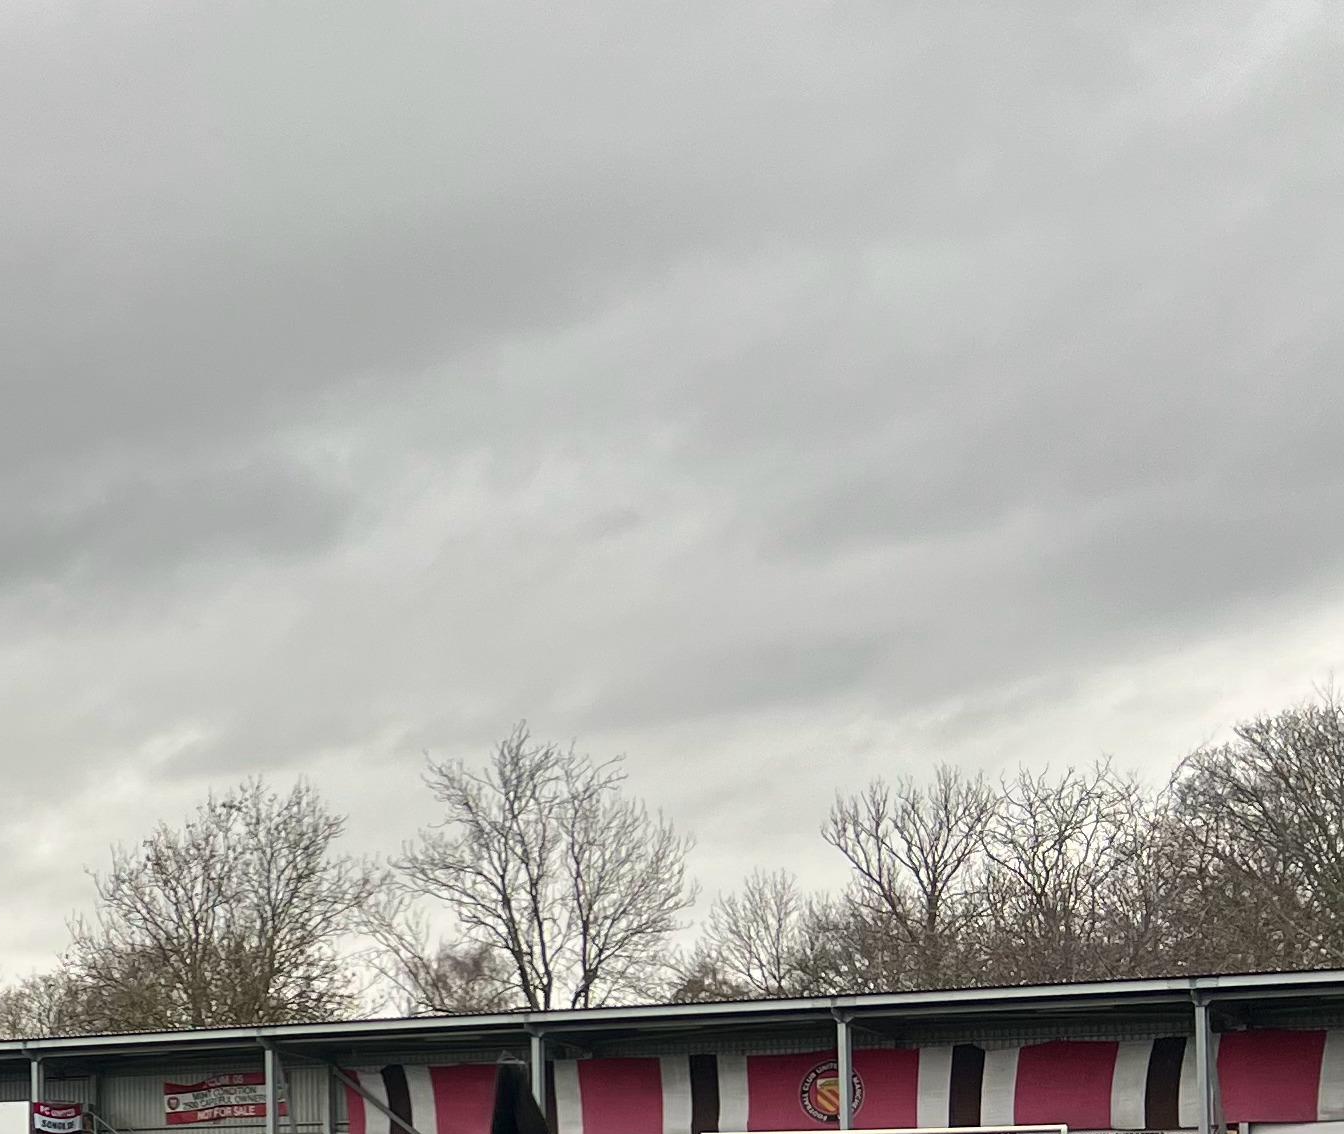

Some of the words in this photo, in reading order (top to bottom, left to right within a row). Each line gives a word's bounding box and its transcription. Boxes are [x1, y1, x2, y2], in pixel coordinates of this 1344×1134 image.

[803, 1073, 817, 1092] CLUB
[213, 1086, 257, 1097] CONDITION
[197, 1110, 213, 1120] NOT
[214, 1107, 232, 1118] FOR
[234, 1106, 256, 1116] SALE
